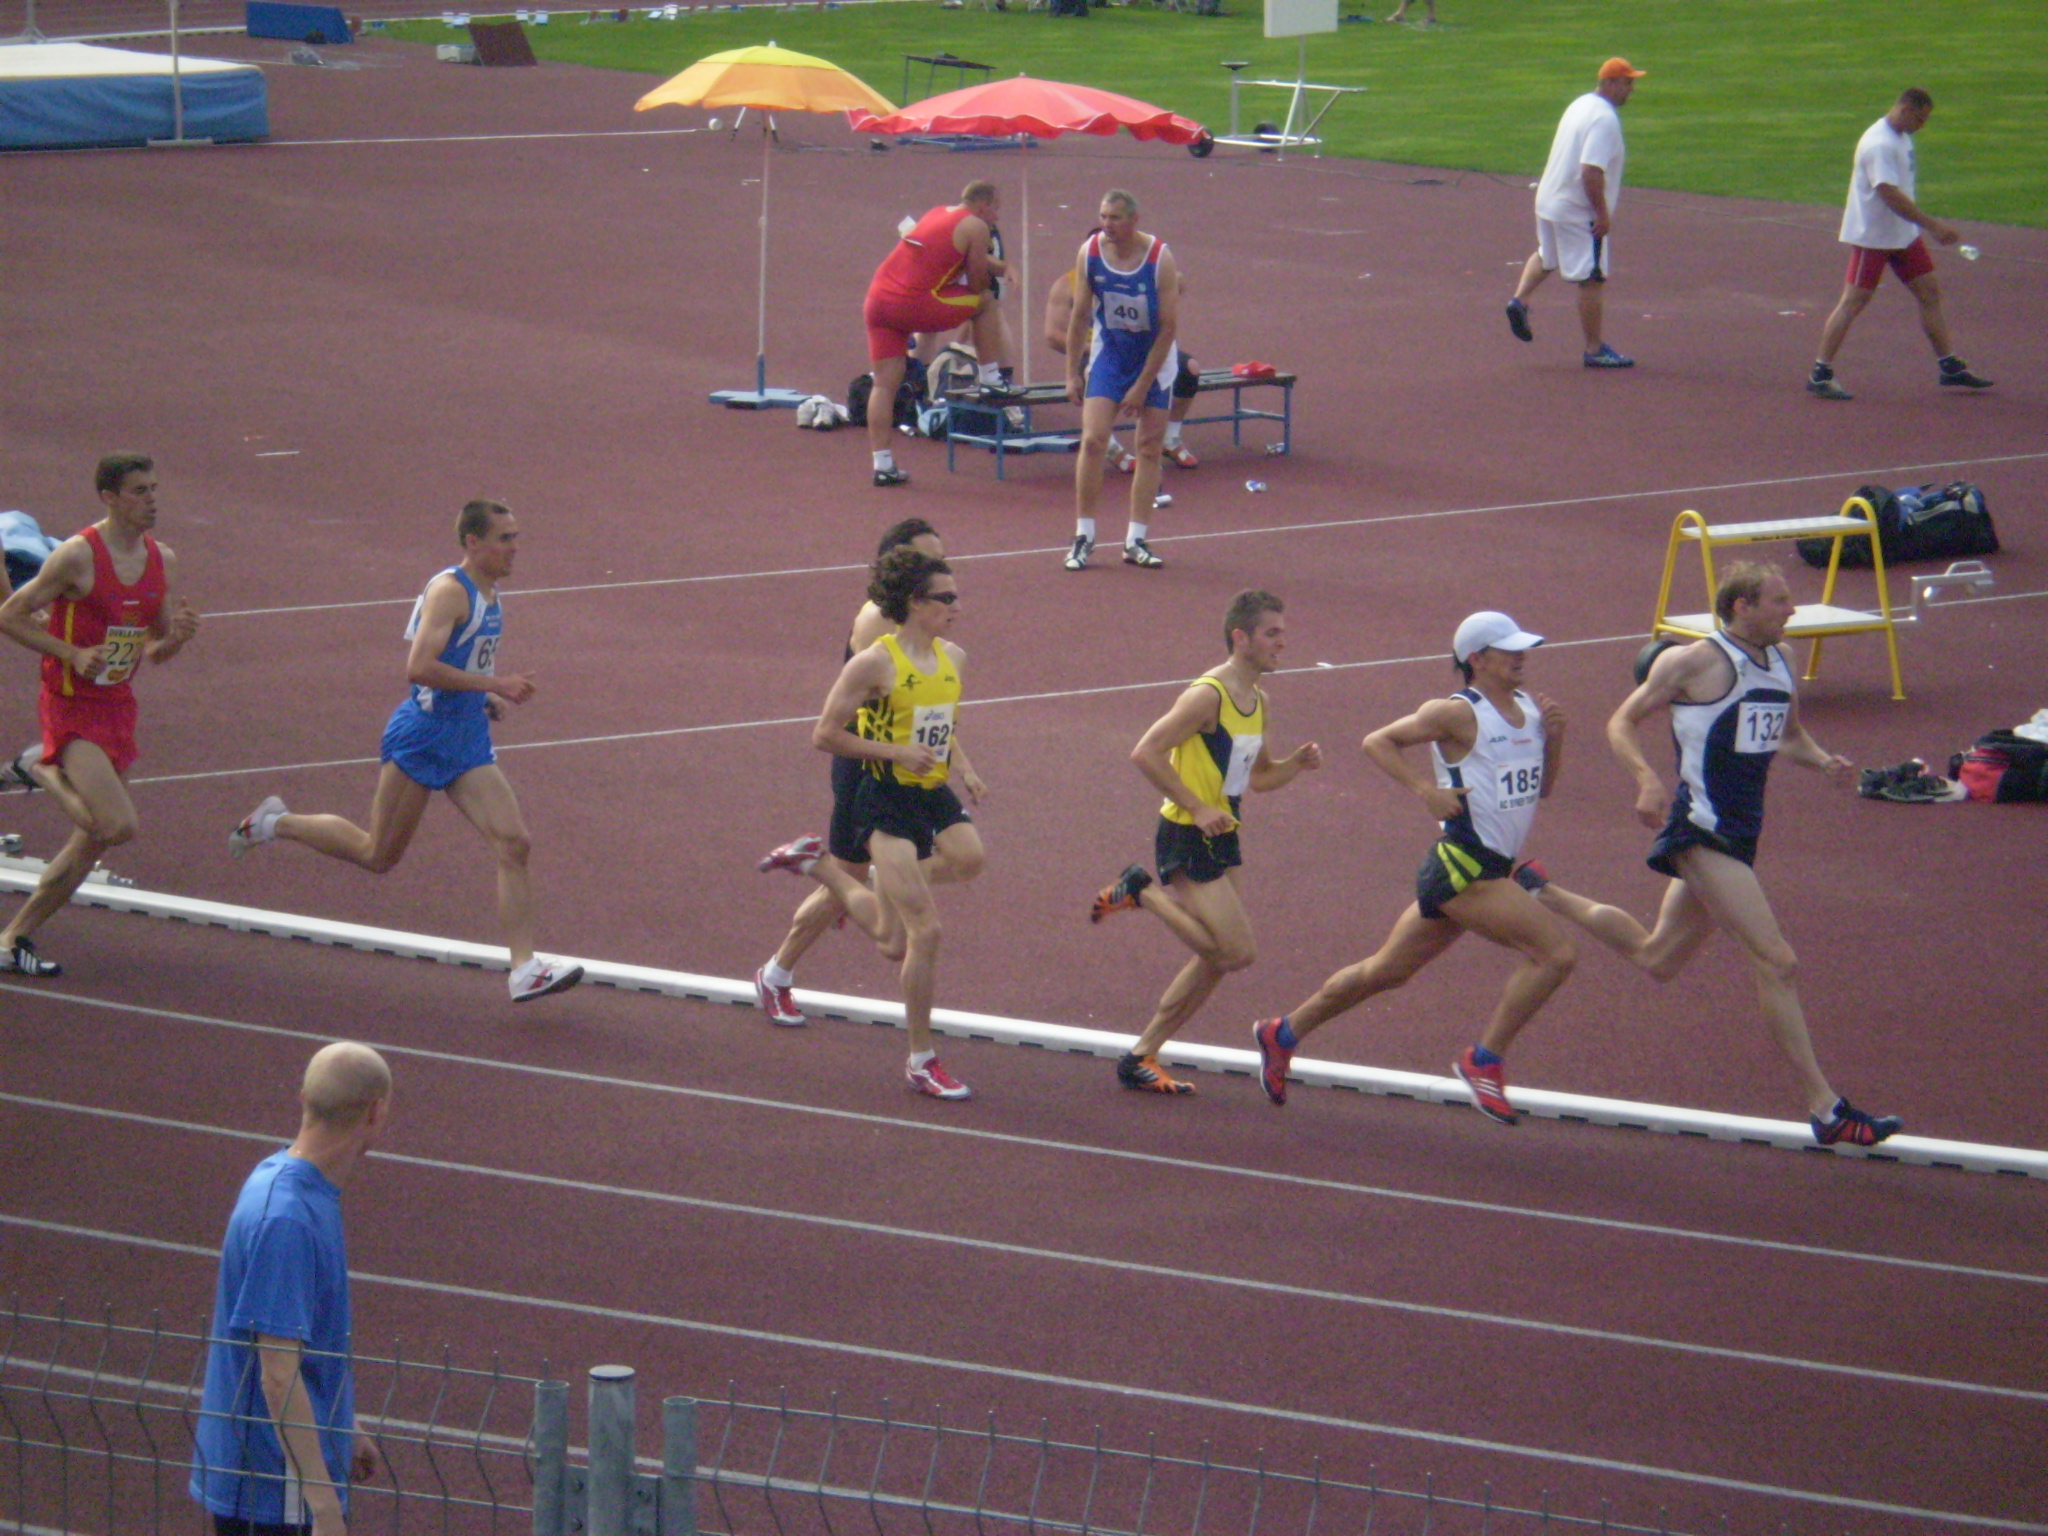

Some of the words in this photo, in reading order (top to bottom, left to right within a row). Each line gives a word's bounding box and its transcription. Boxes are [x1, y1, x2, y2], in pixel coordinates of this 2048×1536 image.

[1114, 305, 1139, 320] 40
[916, 724, 950, 748] 162
[1747, 711, 1785, 742] 132
[1500, 766, 1541, 795] 185
